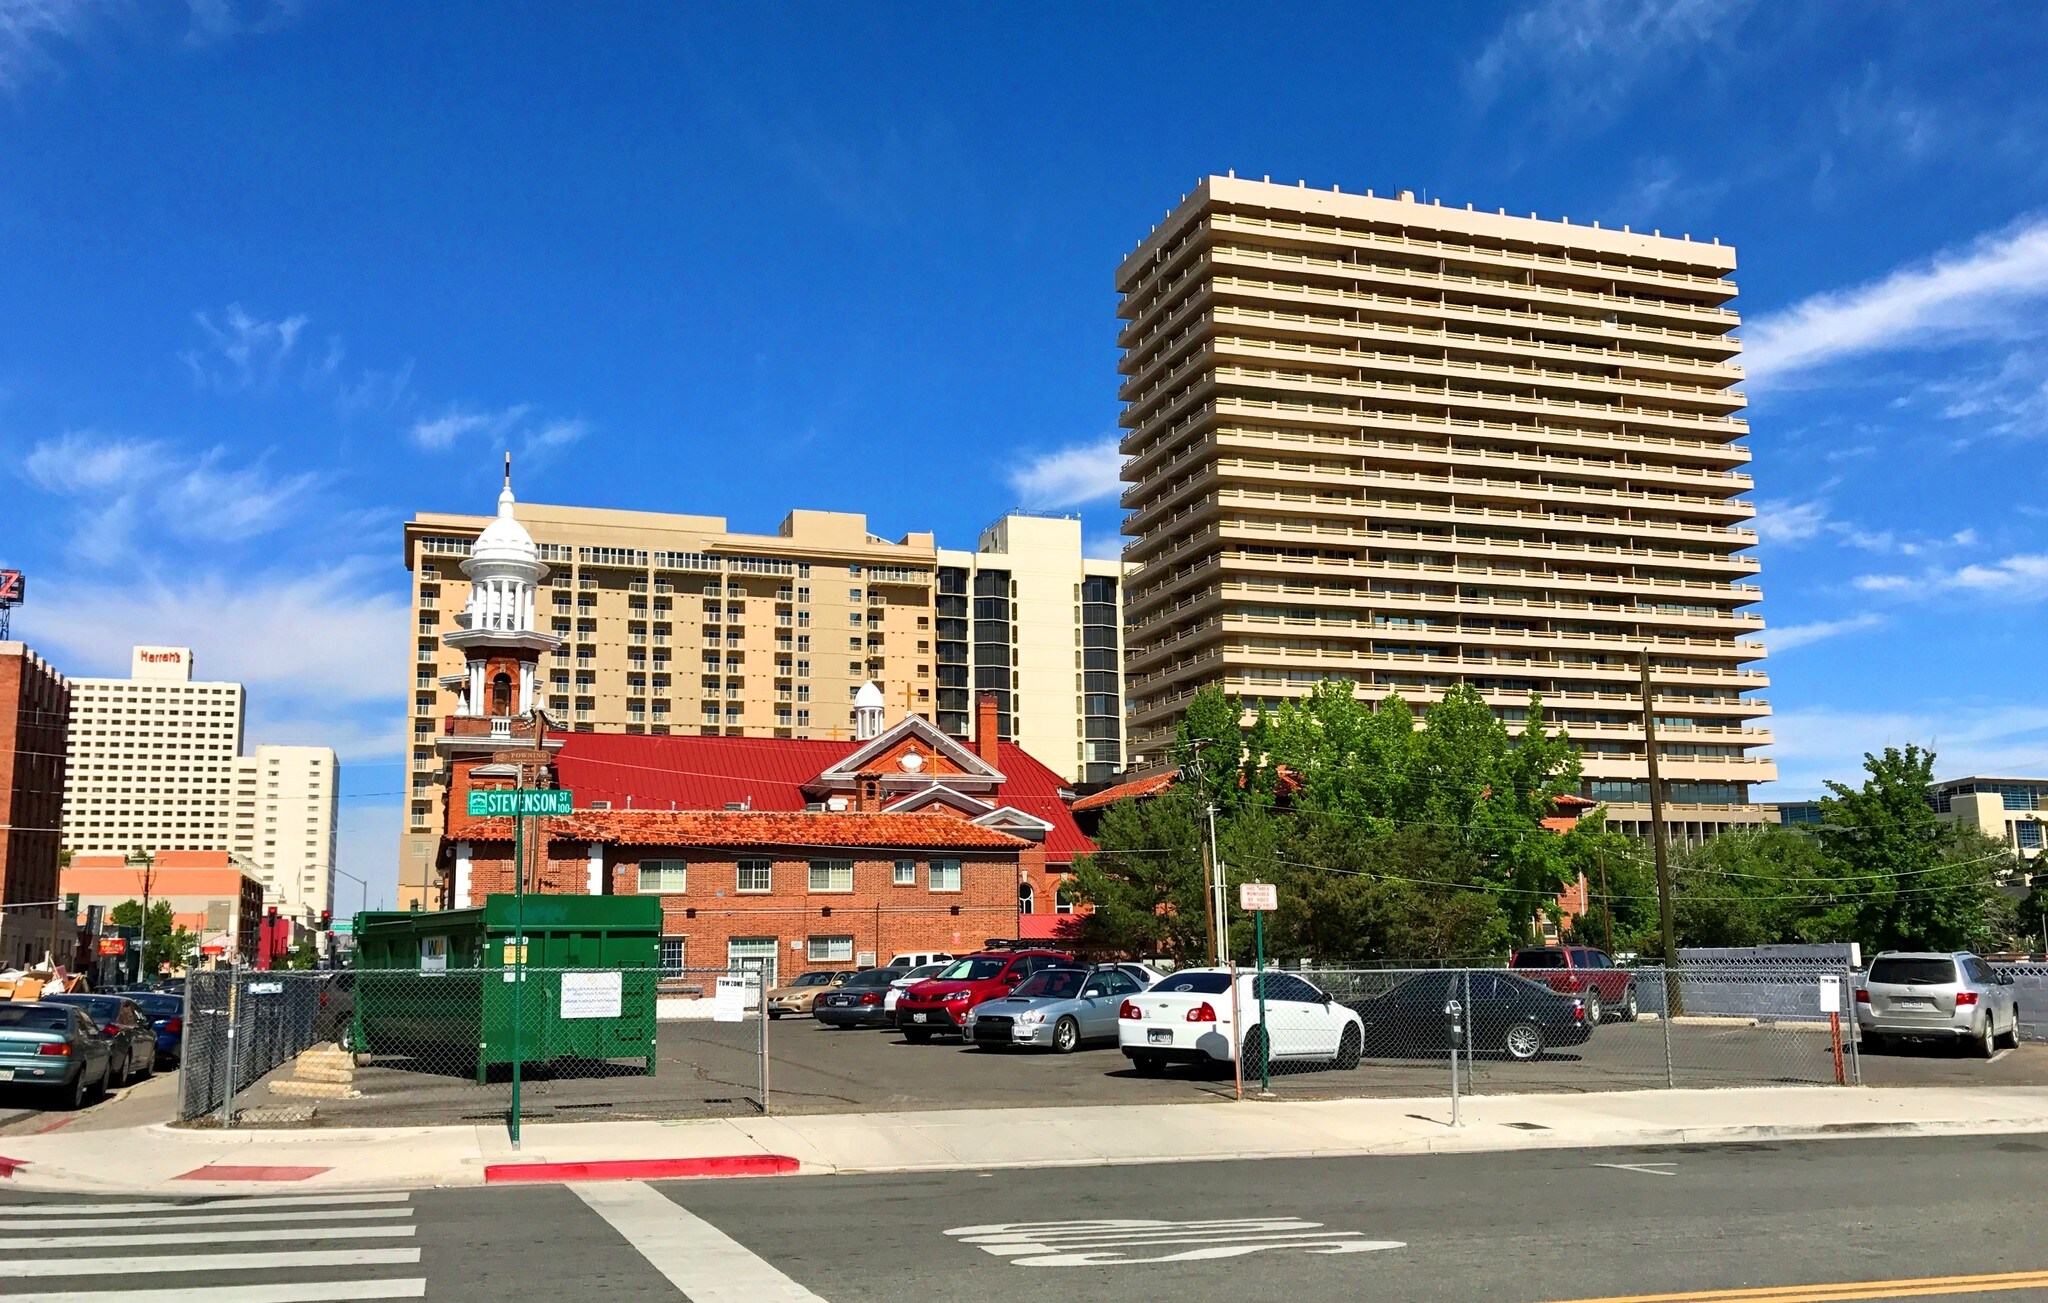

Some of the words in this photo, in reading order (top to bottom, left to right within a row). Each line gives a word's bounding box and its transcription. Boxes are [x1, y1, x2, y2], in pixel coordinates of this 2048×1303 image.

[0, 571, 19, 597] Z
[140, 650, 181, 663] Harrah's
[488, 793, 557, 812] STEVENSON
[559, 792, 568, 801] ST
[557, 803, 570, 813] 100
[730, 980, 743, 988] ZONE
[942, 1216, 1408, 1267] STOP
